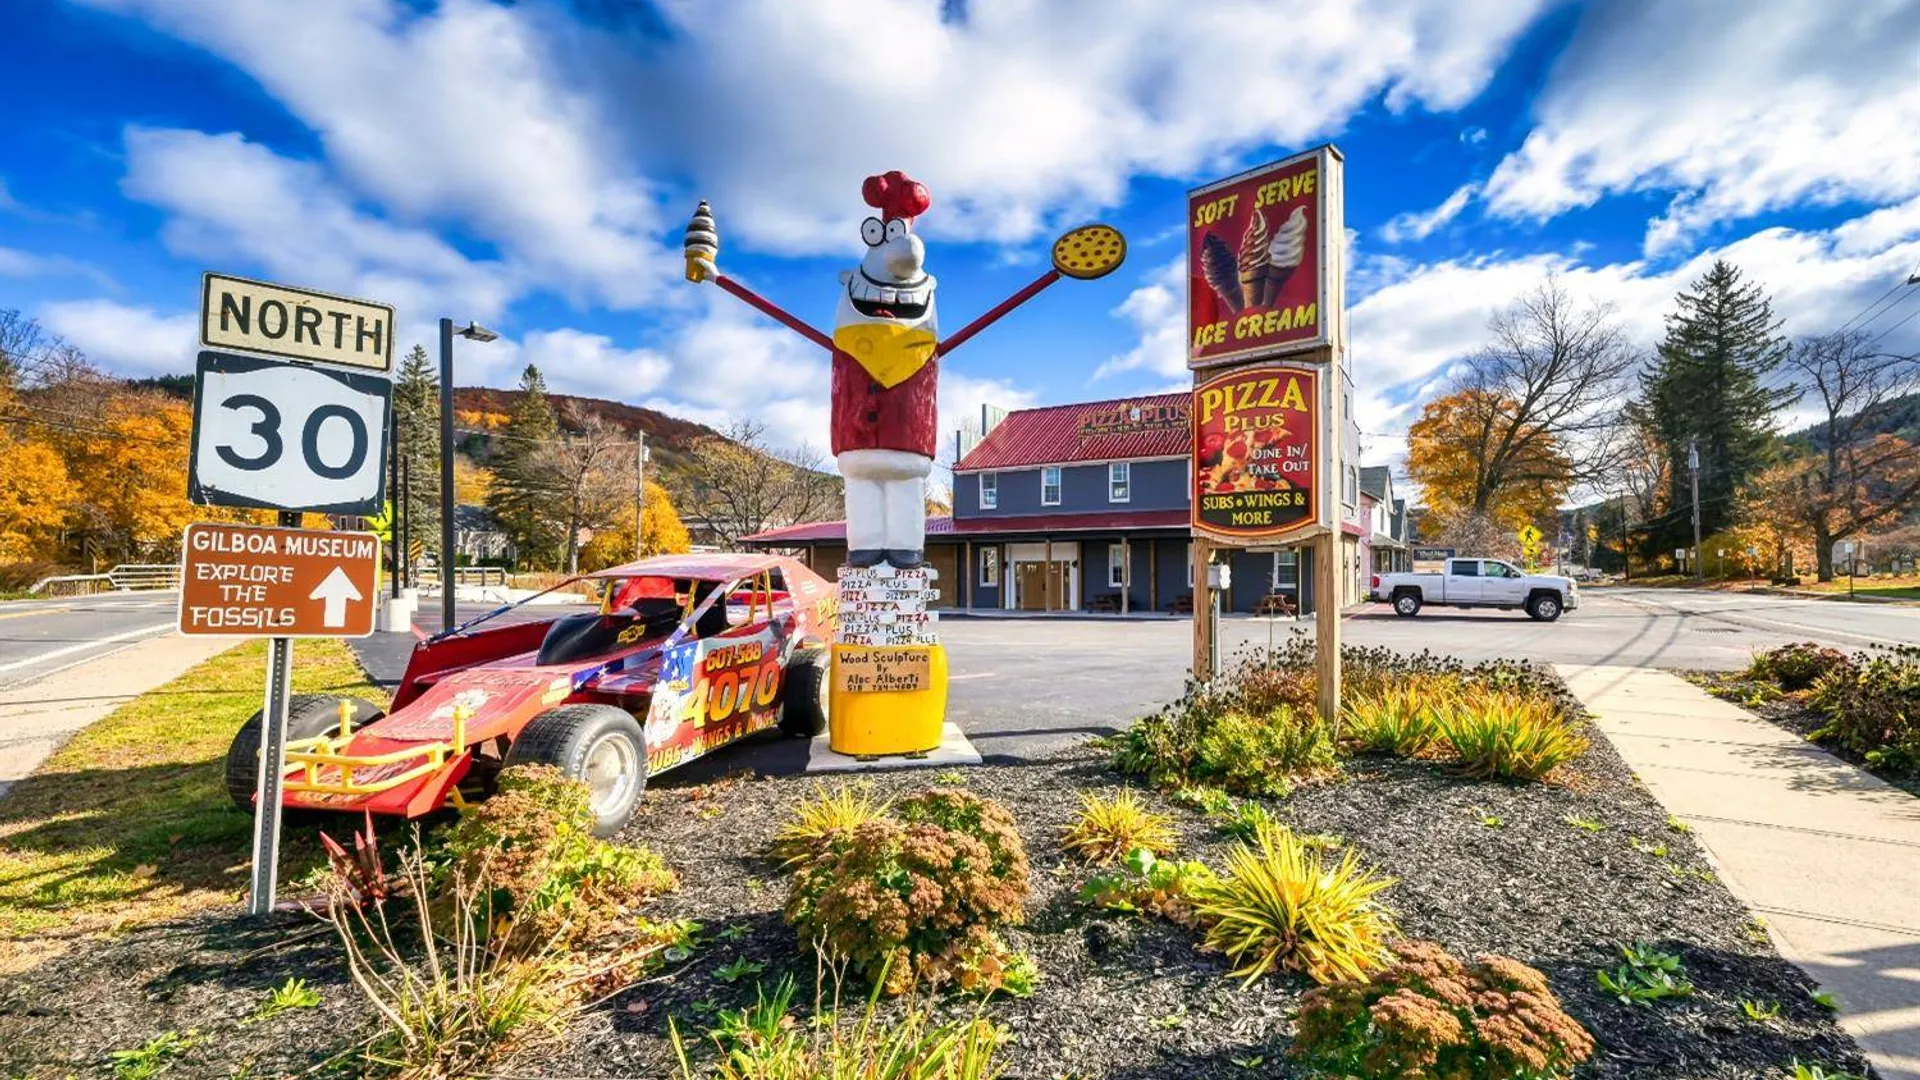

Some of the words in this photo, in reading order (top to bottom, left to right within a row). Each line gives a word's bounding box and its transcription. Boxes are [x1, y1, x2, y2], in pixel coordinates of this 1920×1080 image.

[1194, 193, 1239, 228] SOFT
[1254, 168, 1317, 210] SERVE
[219, 291, 383, 356] NORTH
[1193, 320, 1229, 350] ICE
[1234, 302, 1316, 340] CREAM
[1200, 376, 1308, 426] PIZZA
[1141, 404, 1189, 422] PLUS
[1224, 412, 1285, 434] PLUS
[214, 393, 369, 480] 30
[1252, 446, 1283, 460] DINE
[1248, 463, 1279, 475] TAKE
[1282, 460, 1310, 473] OUT
[1203, 495, 1235, 511] SUBS
[1245, 491, 1291, 508] WINGS
[1294, 492, 1306, 506] &
[1231, 510, 1273, 526] MORE
[192, 530, 278, 554] GILBOA
[284, 536, 374, 559] MUSEUM
[194, 562, 294, 583] EXPLORE
[894, 567, 928, 579] PIZZA
[218, 583, 267, 603] THE
[841, 580, 872, 589] PIZZA
[880, 579, 909, 589] PLUS
[841, 590, 868, 601] PIZZA
[885, 590, 910, 600] PIZZA
[856, 602, 900, 612] PIZZA
[189, 606, 297, 629] FOSSILS
[896, 613, 930, 623] PIZZA
[843, 634, 873, 645] PIZZA
[885, 635, 912, 645] PIZZA
[844, 624, 880, 634] PIZZA
[885, 624, 913, 635] PLUS
[705, 640, 763, 673] 607-588
[840, 652, 869, 664] Wood
[872, 651, 929, 666] Sculpture
[847, 674, 871, 684] Alec
[875, 673, 920, 684] Alberti
[679, 658, 781, 729] 4070
[692, 722, 731, 757] WINGS
[735, 722, 743, 739] &
